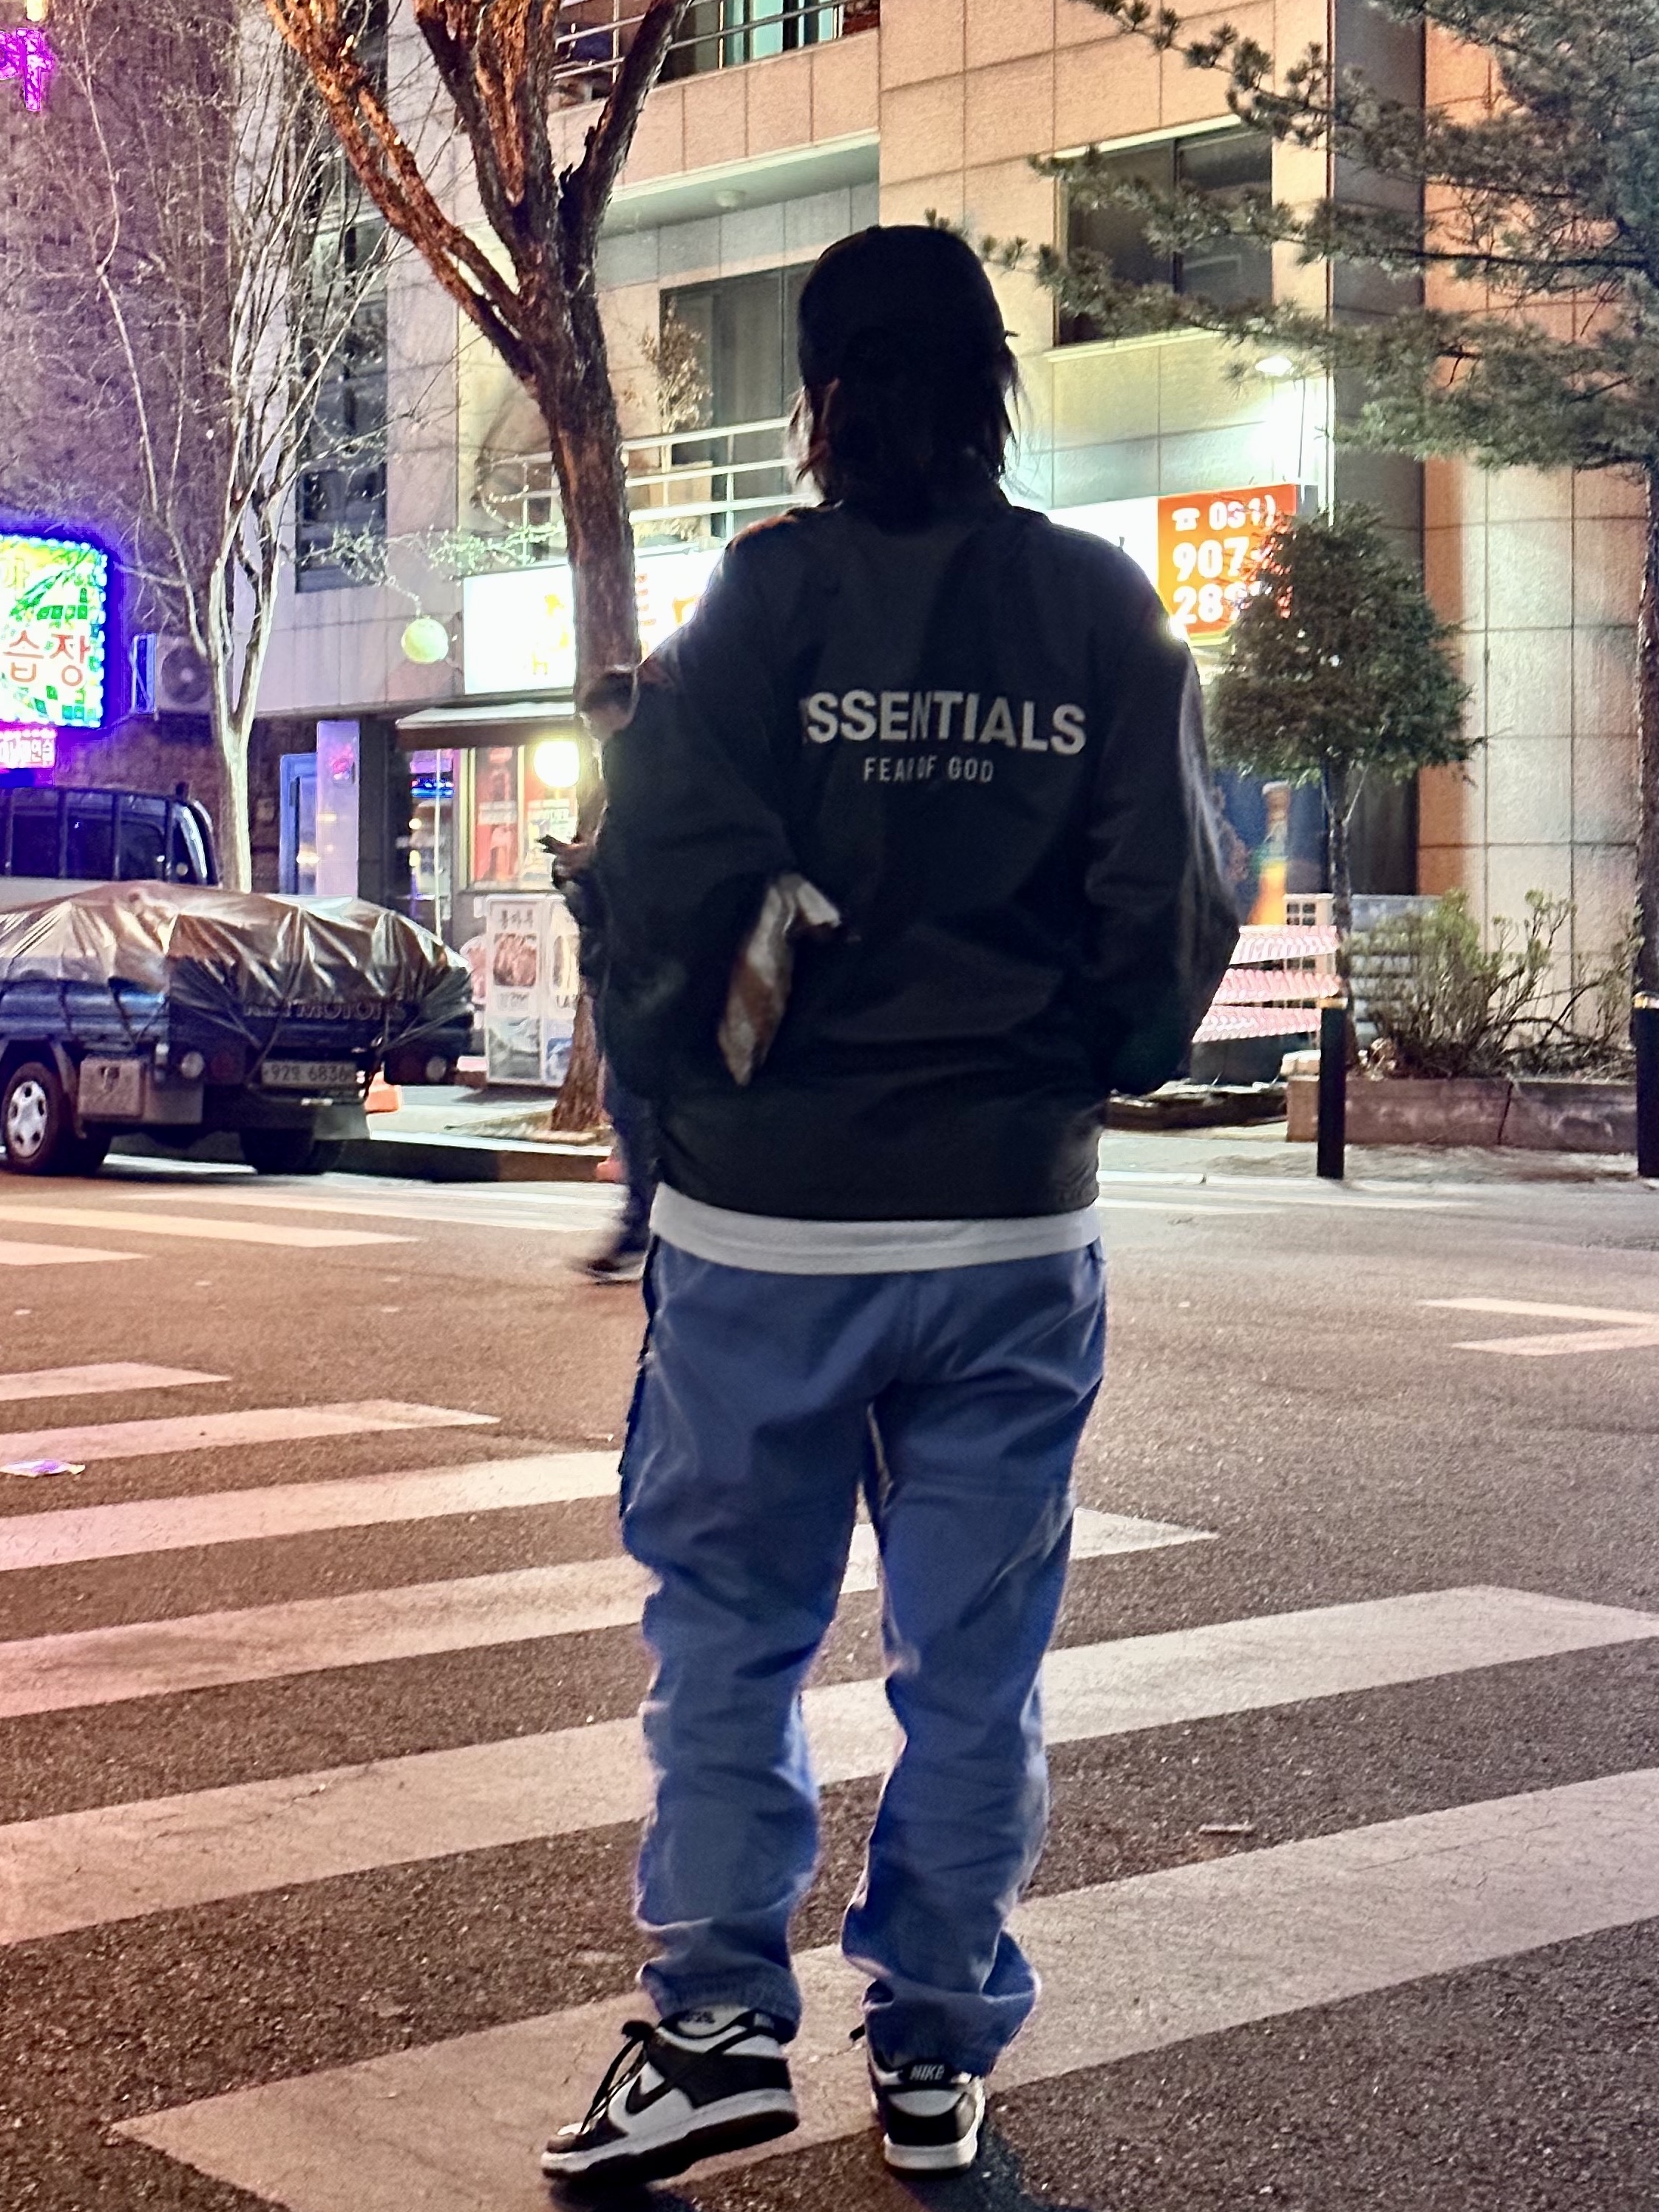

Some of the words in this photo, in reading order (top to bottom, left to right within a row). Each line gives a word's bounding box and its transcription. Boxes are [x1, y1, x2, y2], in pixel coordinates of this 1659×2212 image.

[799, 689, 1087, 756] SSENTIALS
[948, 756, 994, 783] GOD
[909, 2063, 945, 2081] NIKE
